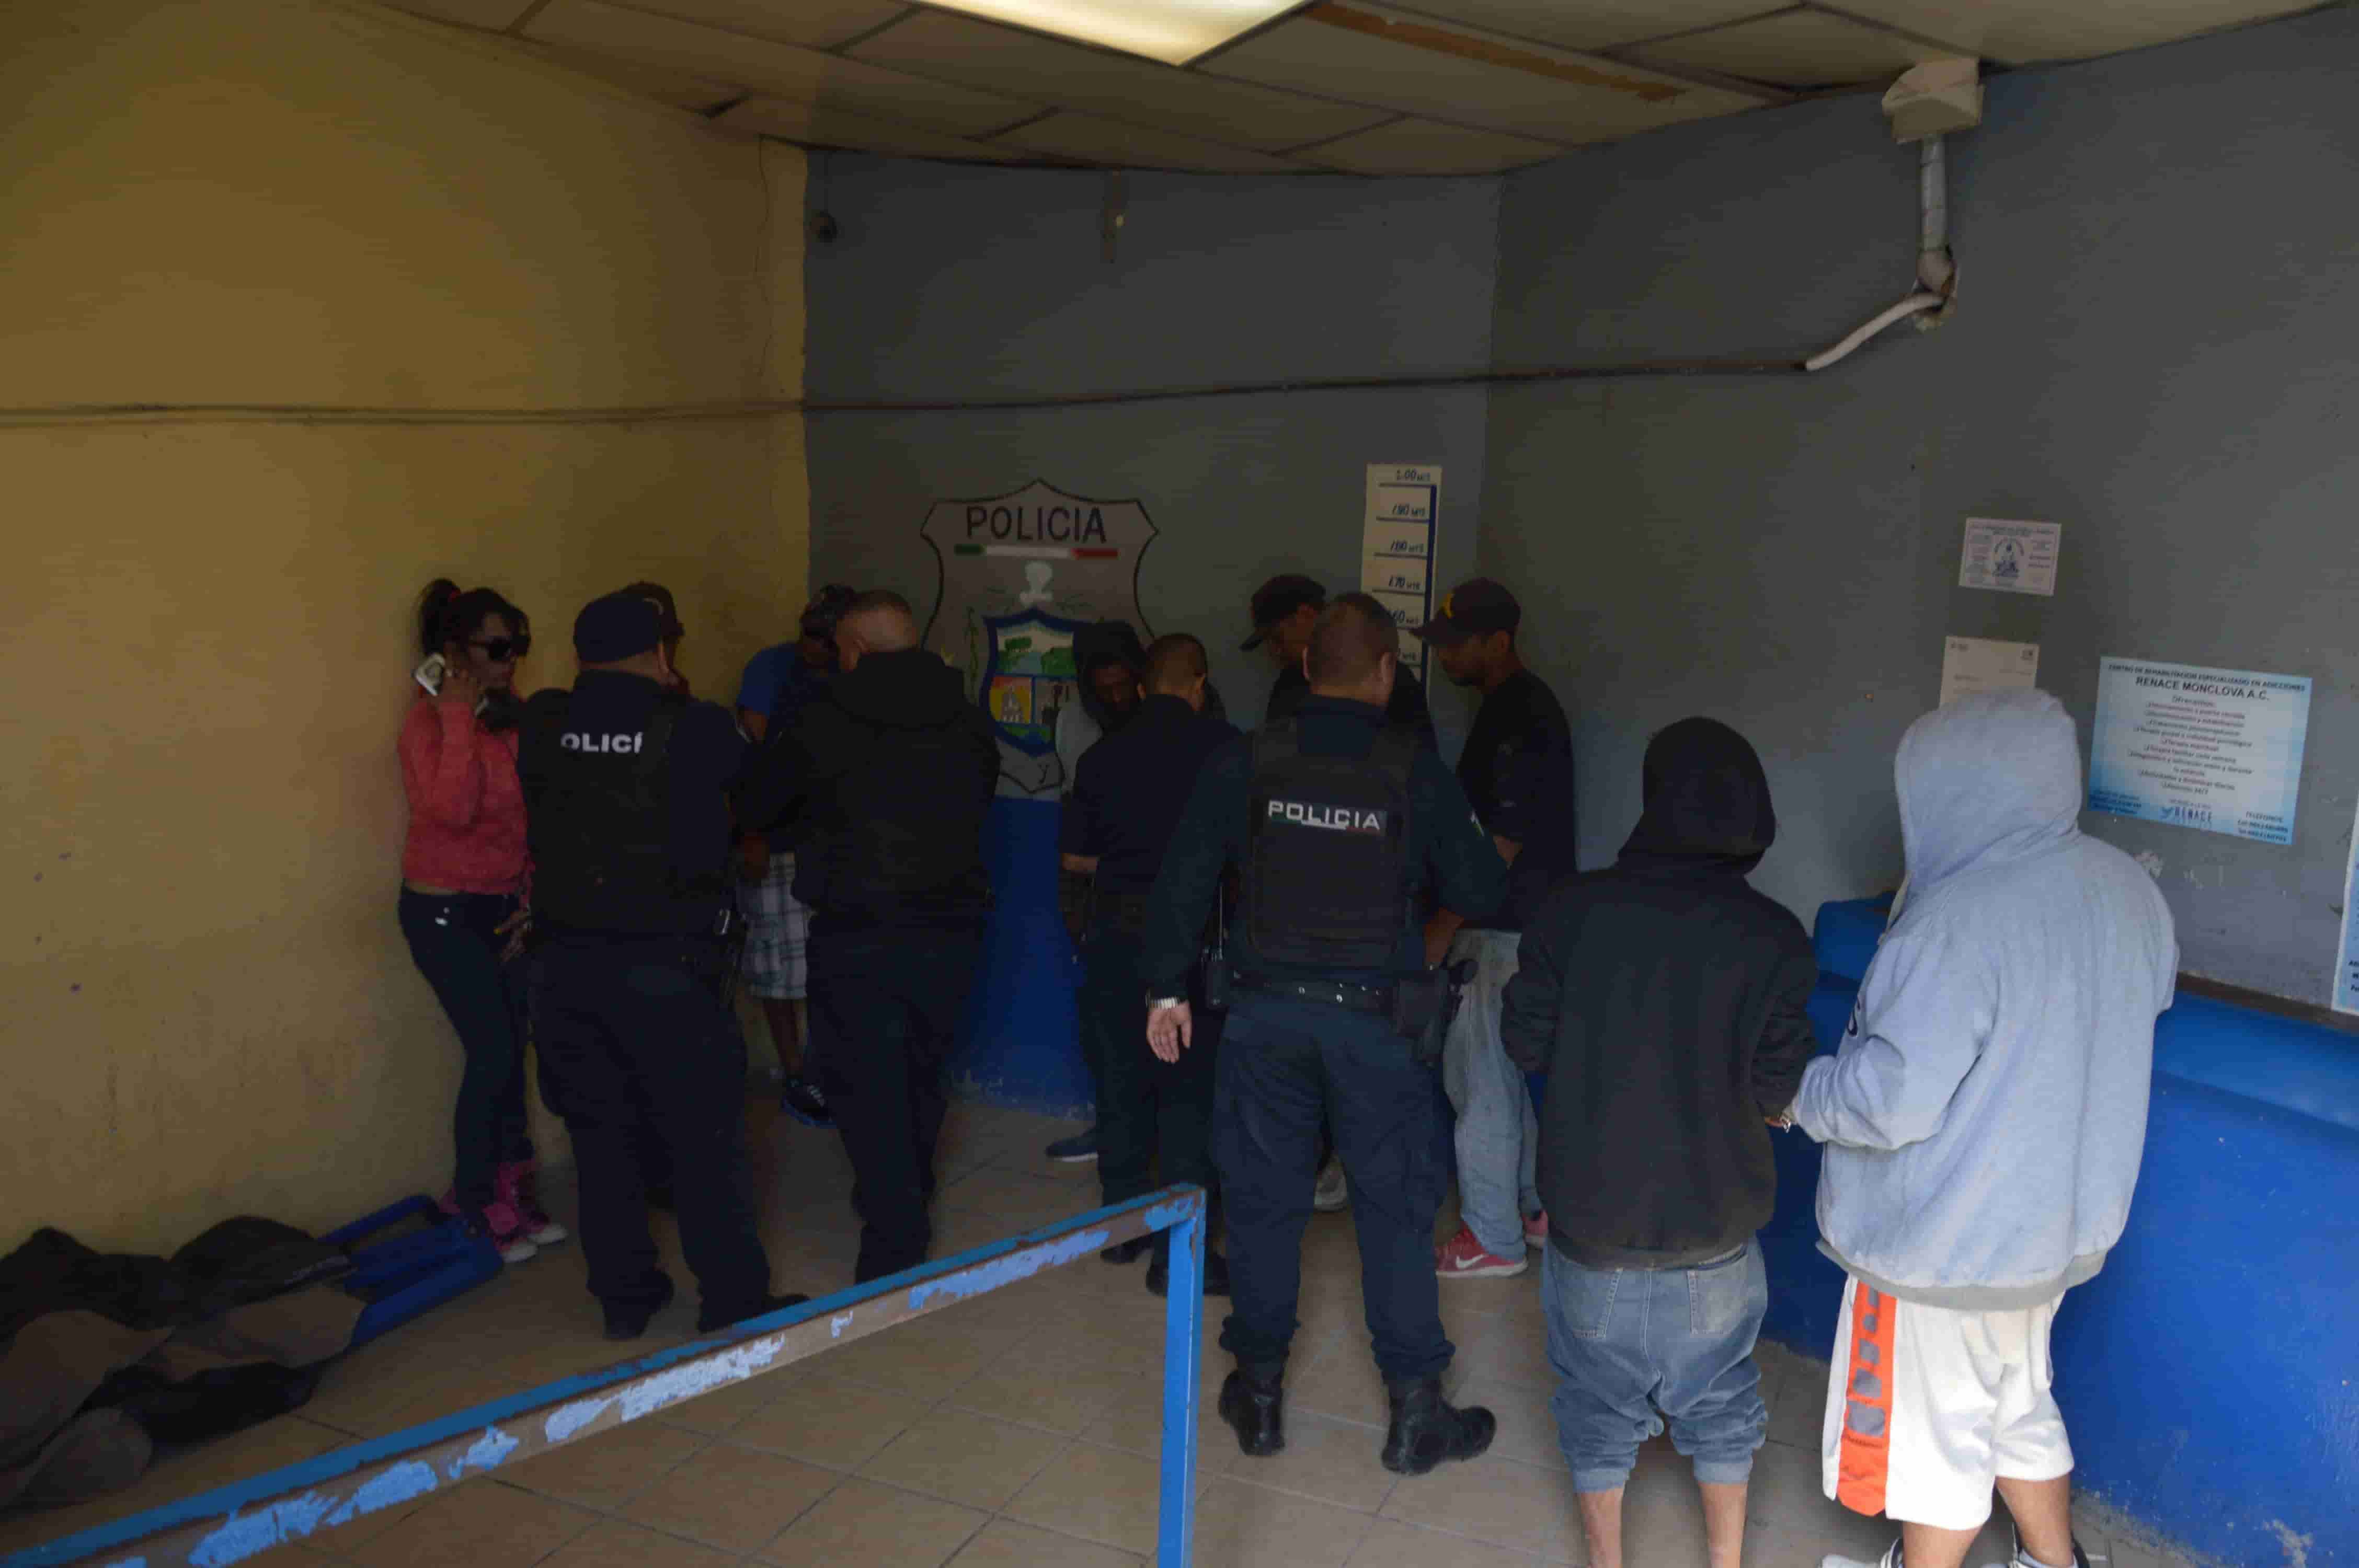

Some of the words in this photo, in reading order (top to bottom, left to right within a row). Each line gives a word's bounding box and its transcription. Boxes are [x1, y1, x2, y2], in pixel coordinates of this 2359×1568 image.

[966, 506, 1107, 543] POLICIA
[2135, 676, 2179, 690] RENACE
[2182, 682, 2245, 698] MONCLOVA
[1268, 800, 1381, 830] POLICIA
